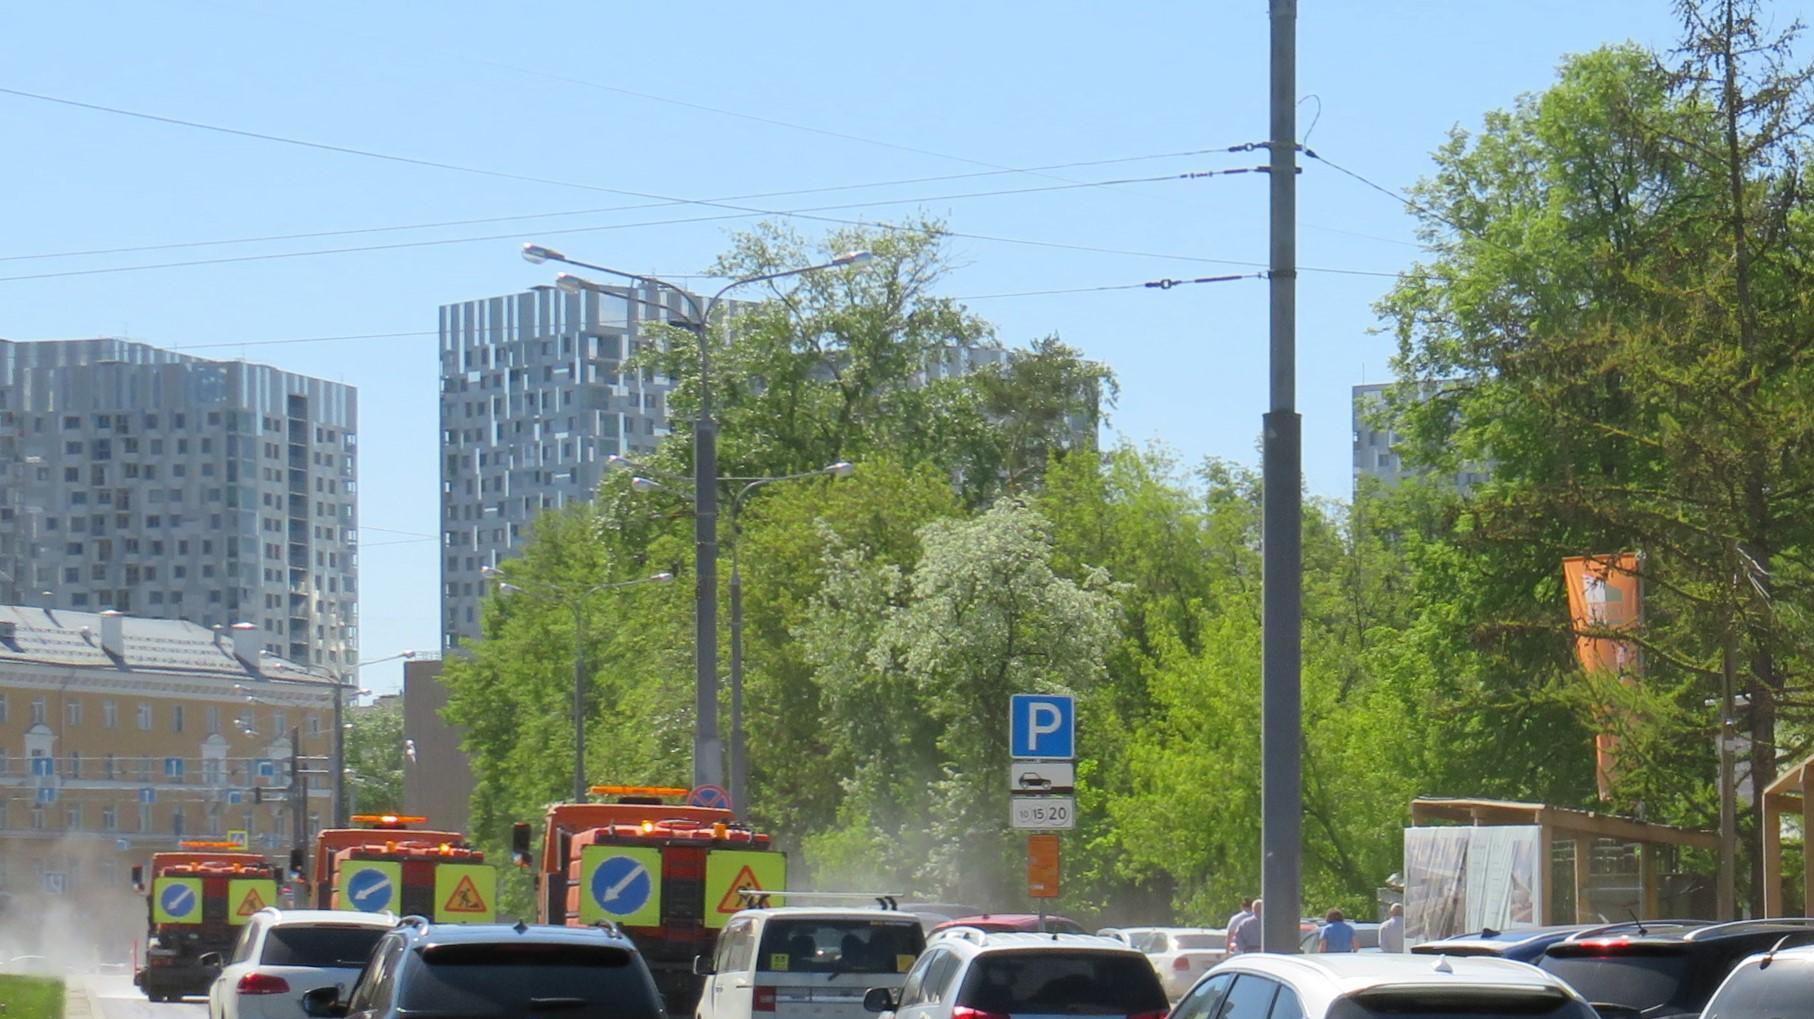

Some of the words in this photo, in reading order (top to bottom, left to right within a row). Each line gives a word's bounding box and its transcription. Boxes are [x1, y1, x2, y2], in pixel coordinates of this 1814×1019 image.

[1028, 702, 1062, 751] P
[1032, 808, 1045, 820] 15
[1049, 807, 1067, 821] 20
